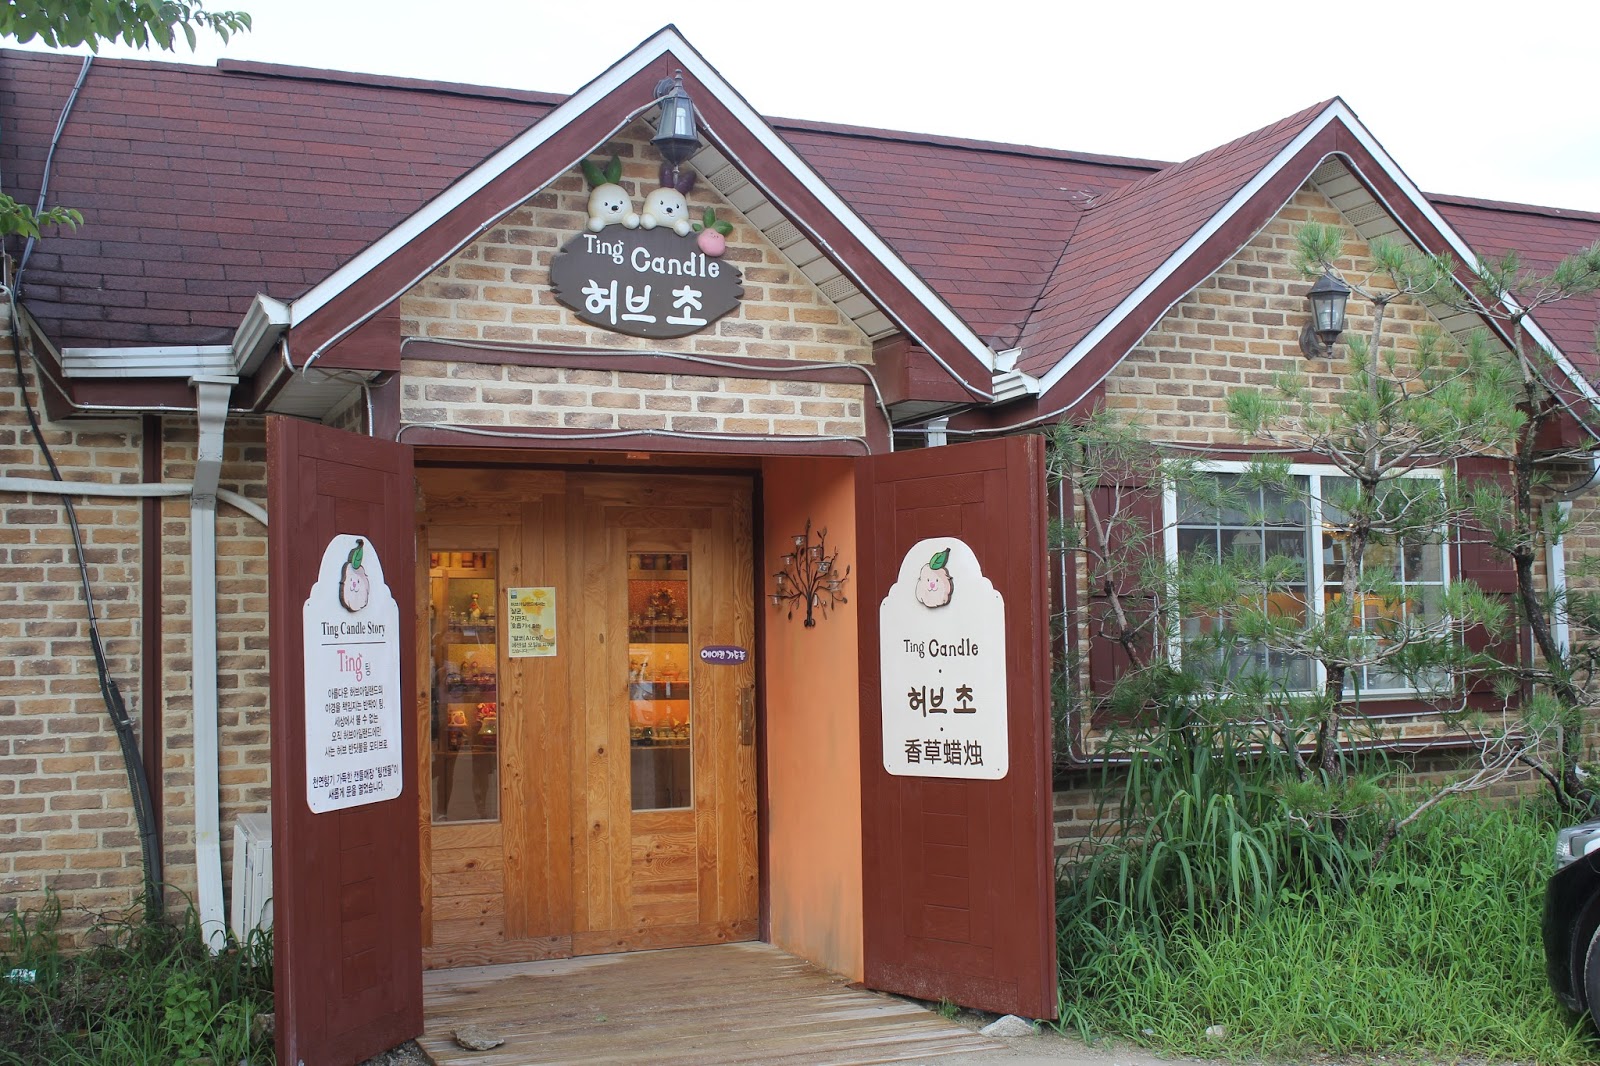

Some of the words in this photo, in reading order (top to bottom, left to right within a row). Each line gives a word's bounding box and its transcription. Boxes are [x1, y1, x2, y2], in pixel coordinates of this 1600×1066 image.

[583, 234, 625, 265] Ting
[631, 246, 720, 278] Candle
[321, 622, 339, 639] Ting
[341, 621, 366, 635] Candle
[367, 621, 385, 637] Story
[903, 639, 925, 659] Ting
[928, 638, 979, 658] Candle
[337, 650, 363, 682] Ting
[365, 662, 371, 676] 팅
[328, 687, 348, 699] 아름다운
[350, 685, 383, 697] 허브아일랜드의
[335, 715, 355, 727] 세상에서
[362, 713, 368, 724] 수
[369, 712, 378, 724] 없는
[331, 730, 342, 741] 오직
[325, 746, 335, 757] 사는
[337, 745, 347, 755] 허브
[369, 739, 388, 751] 모티브로
[904, 738, 984, 767] 香草蜡烛
[337, 771, 353, 783] 가득한
[329, 786, 345, 800] 새롭게
[346, 784, 357, 797] 문을
